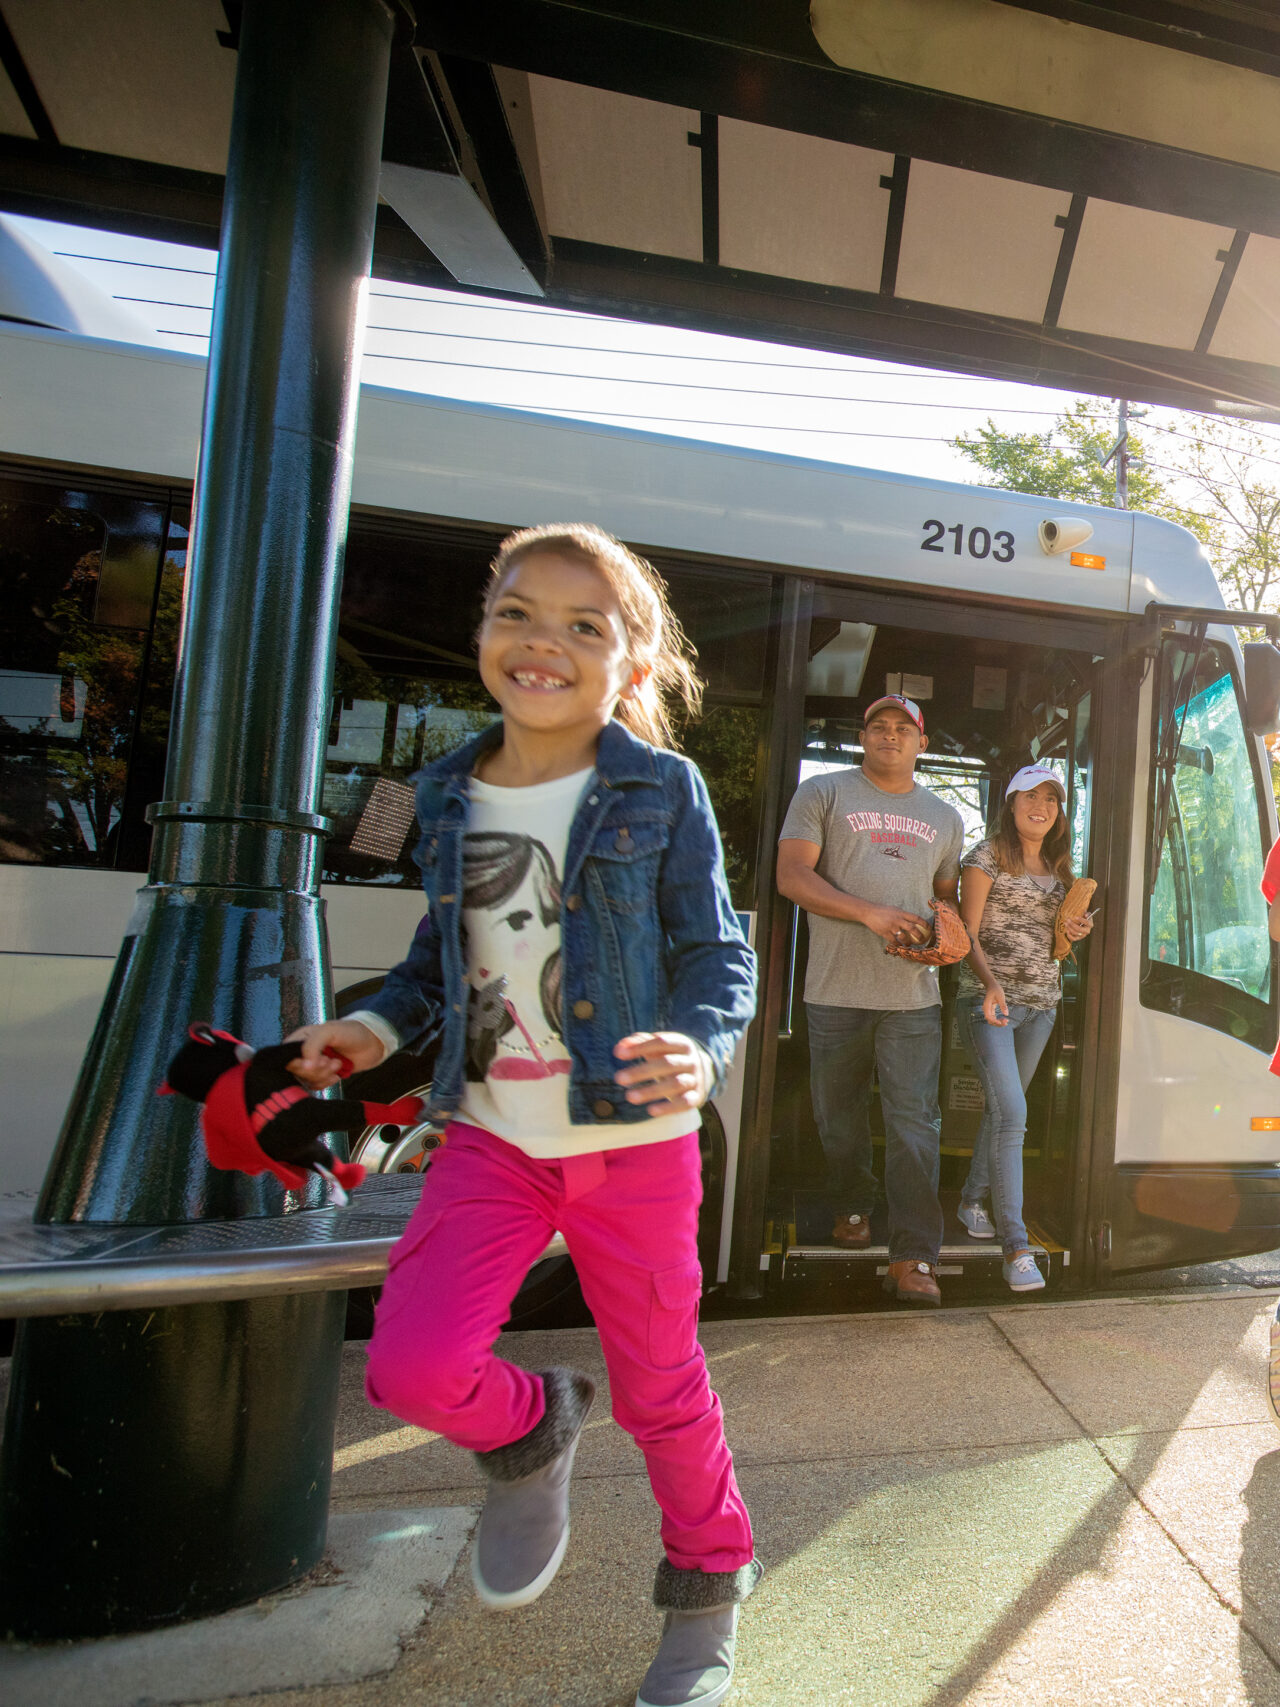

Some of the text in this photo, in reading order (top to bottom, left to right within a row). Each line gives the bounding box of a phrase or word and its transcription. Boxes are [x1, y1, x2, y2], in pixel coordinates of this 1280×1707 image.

[920, 519, 1015, 563] 2103
[846, 811, 937, 843] FLYING SQUIRRELS
[870, 831, 917, 847] BASEBALL
